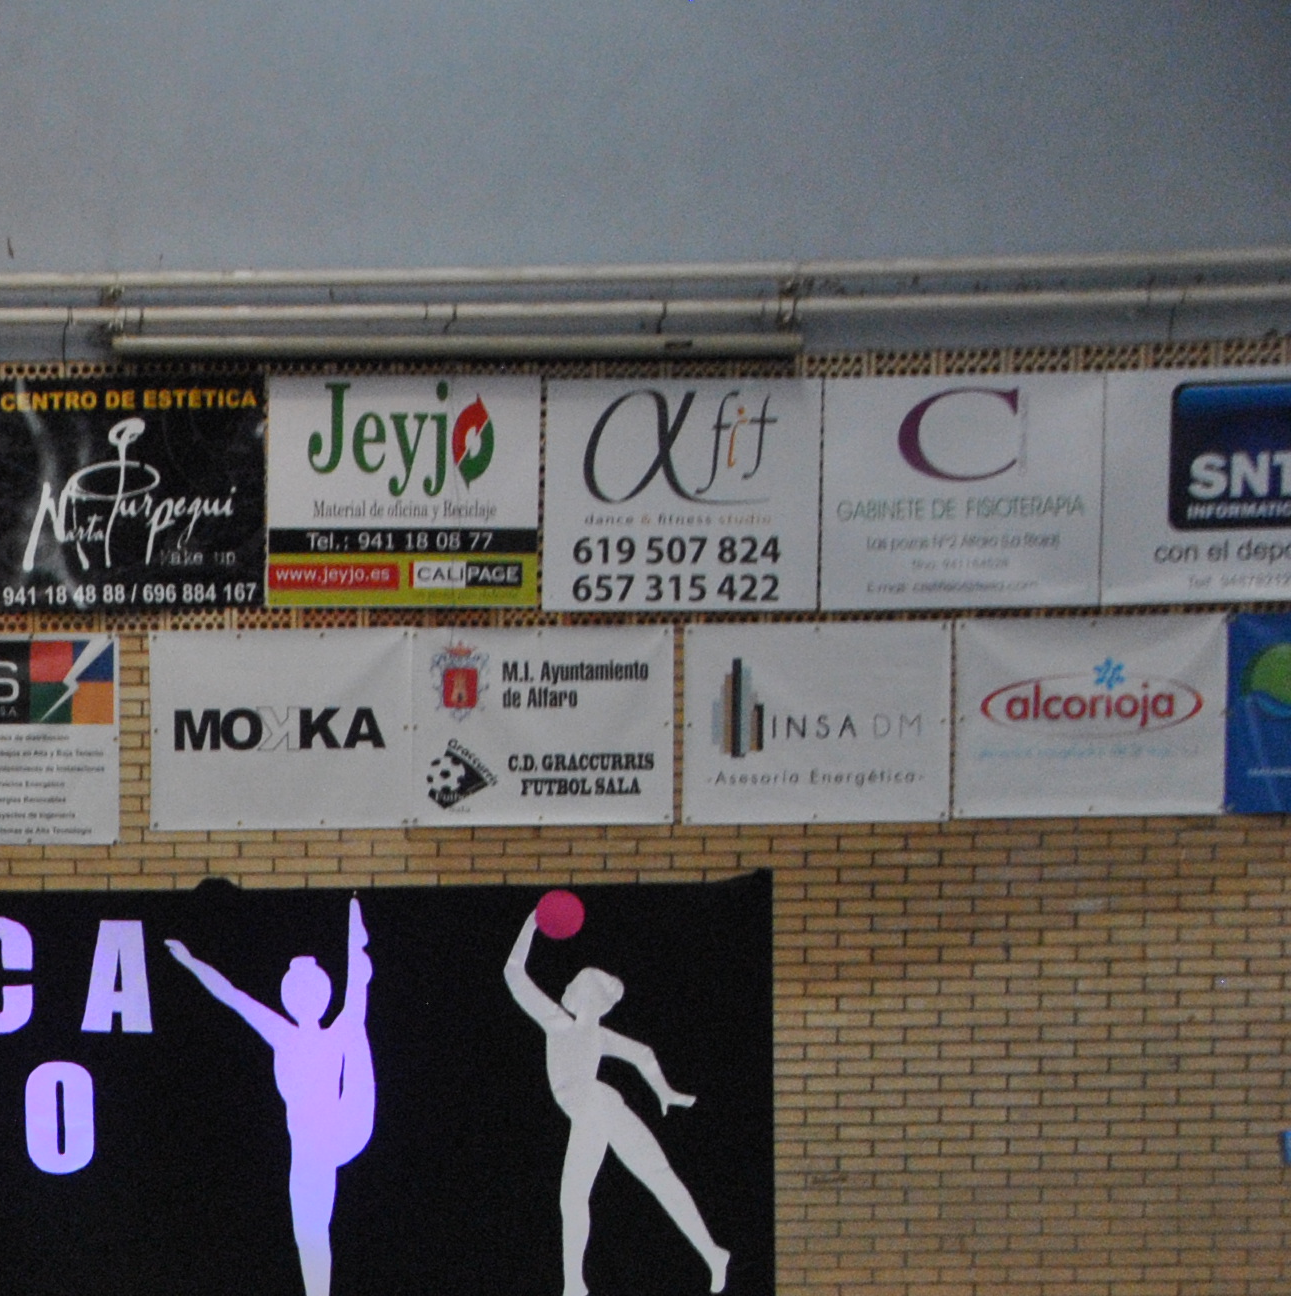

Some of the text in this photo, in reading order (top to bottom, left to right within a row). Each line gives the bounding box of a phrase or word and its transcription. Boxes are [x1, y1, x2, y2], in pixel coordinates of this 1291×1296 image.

[0, 389, 98, 411] CENTRO
[105, 389, 135, 410] DE
[898, 385, 1019, 483] C
[313, 500, 498, 521] Material de oficina y Reciclaje
[584, 512, 635, 526] dance
[658, 512, 712, 526] fitness
[836, 495, 1085, 522] GABINETE DE FISIOTERAPIA
[306, 532, 493, 550] Tel.: 941 18 08 77
[573, 535, 781, 564] 619 507 824
[1154, 543, 1199, 563] con
[1207, 540, 1229, 562] el
[276, 565, 391, 584] www.jeyjo.es
[2, 582, 257, 606] 941 18 48 88 / 696 884 167
[572, 573, 780, 602] 657 315 422
[540, 660, 650, 685] Ayuntamiento
[502, 687, 579, 709] de Alfaro
[1006, 679, 1176, 729] alcorioja
[771, 713, 858, 740] INSA
[508, 753, 655, 772] C.D. GRACCURRIS
[520, 777, 642, 797] FUTBOL SALA
